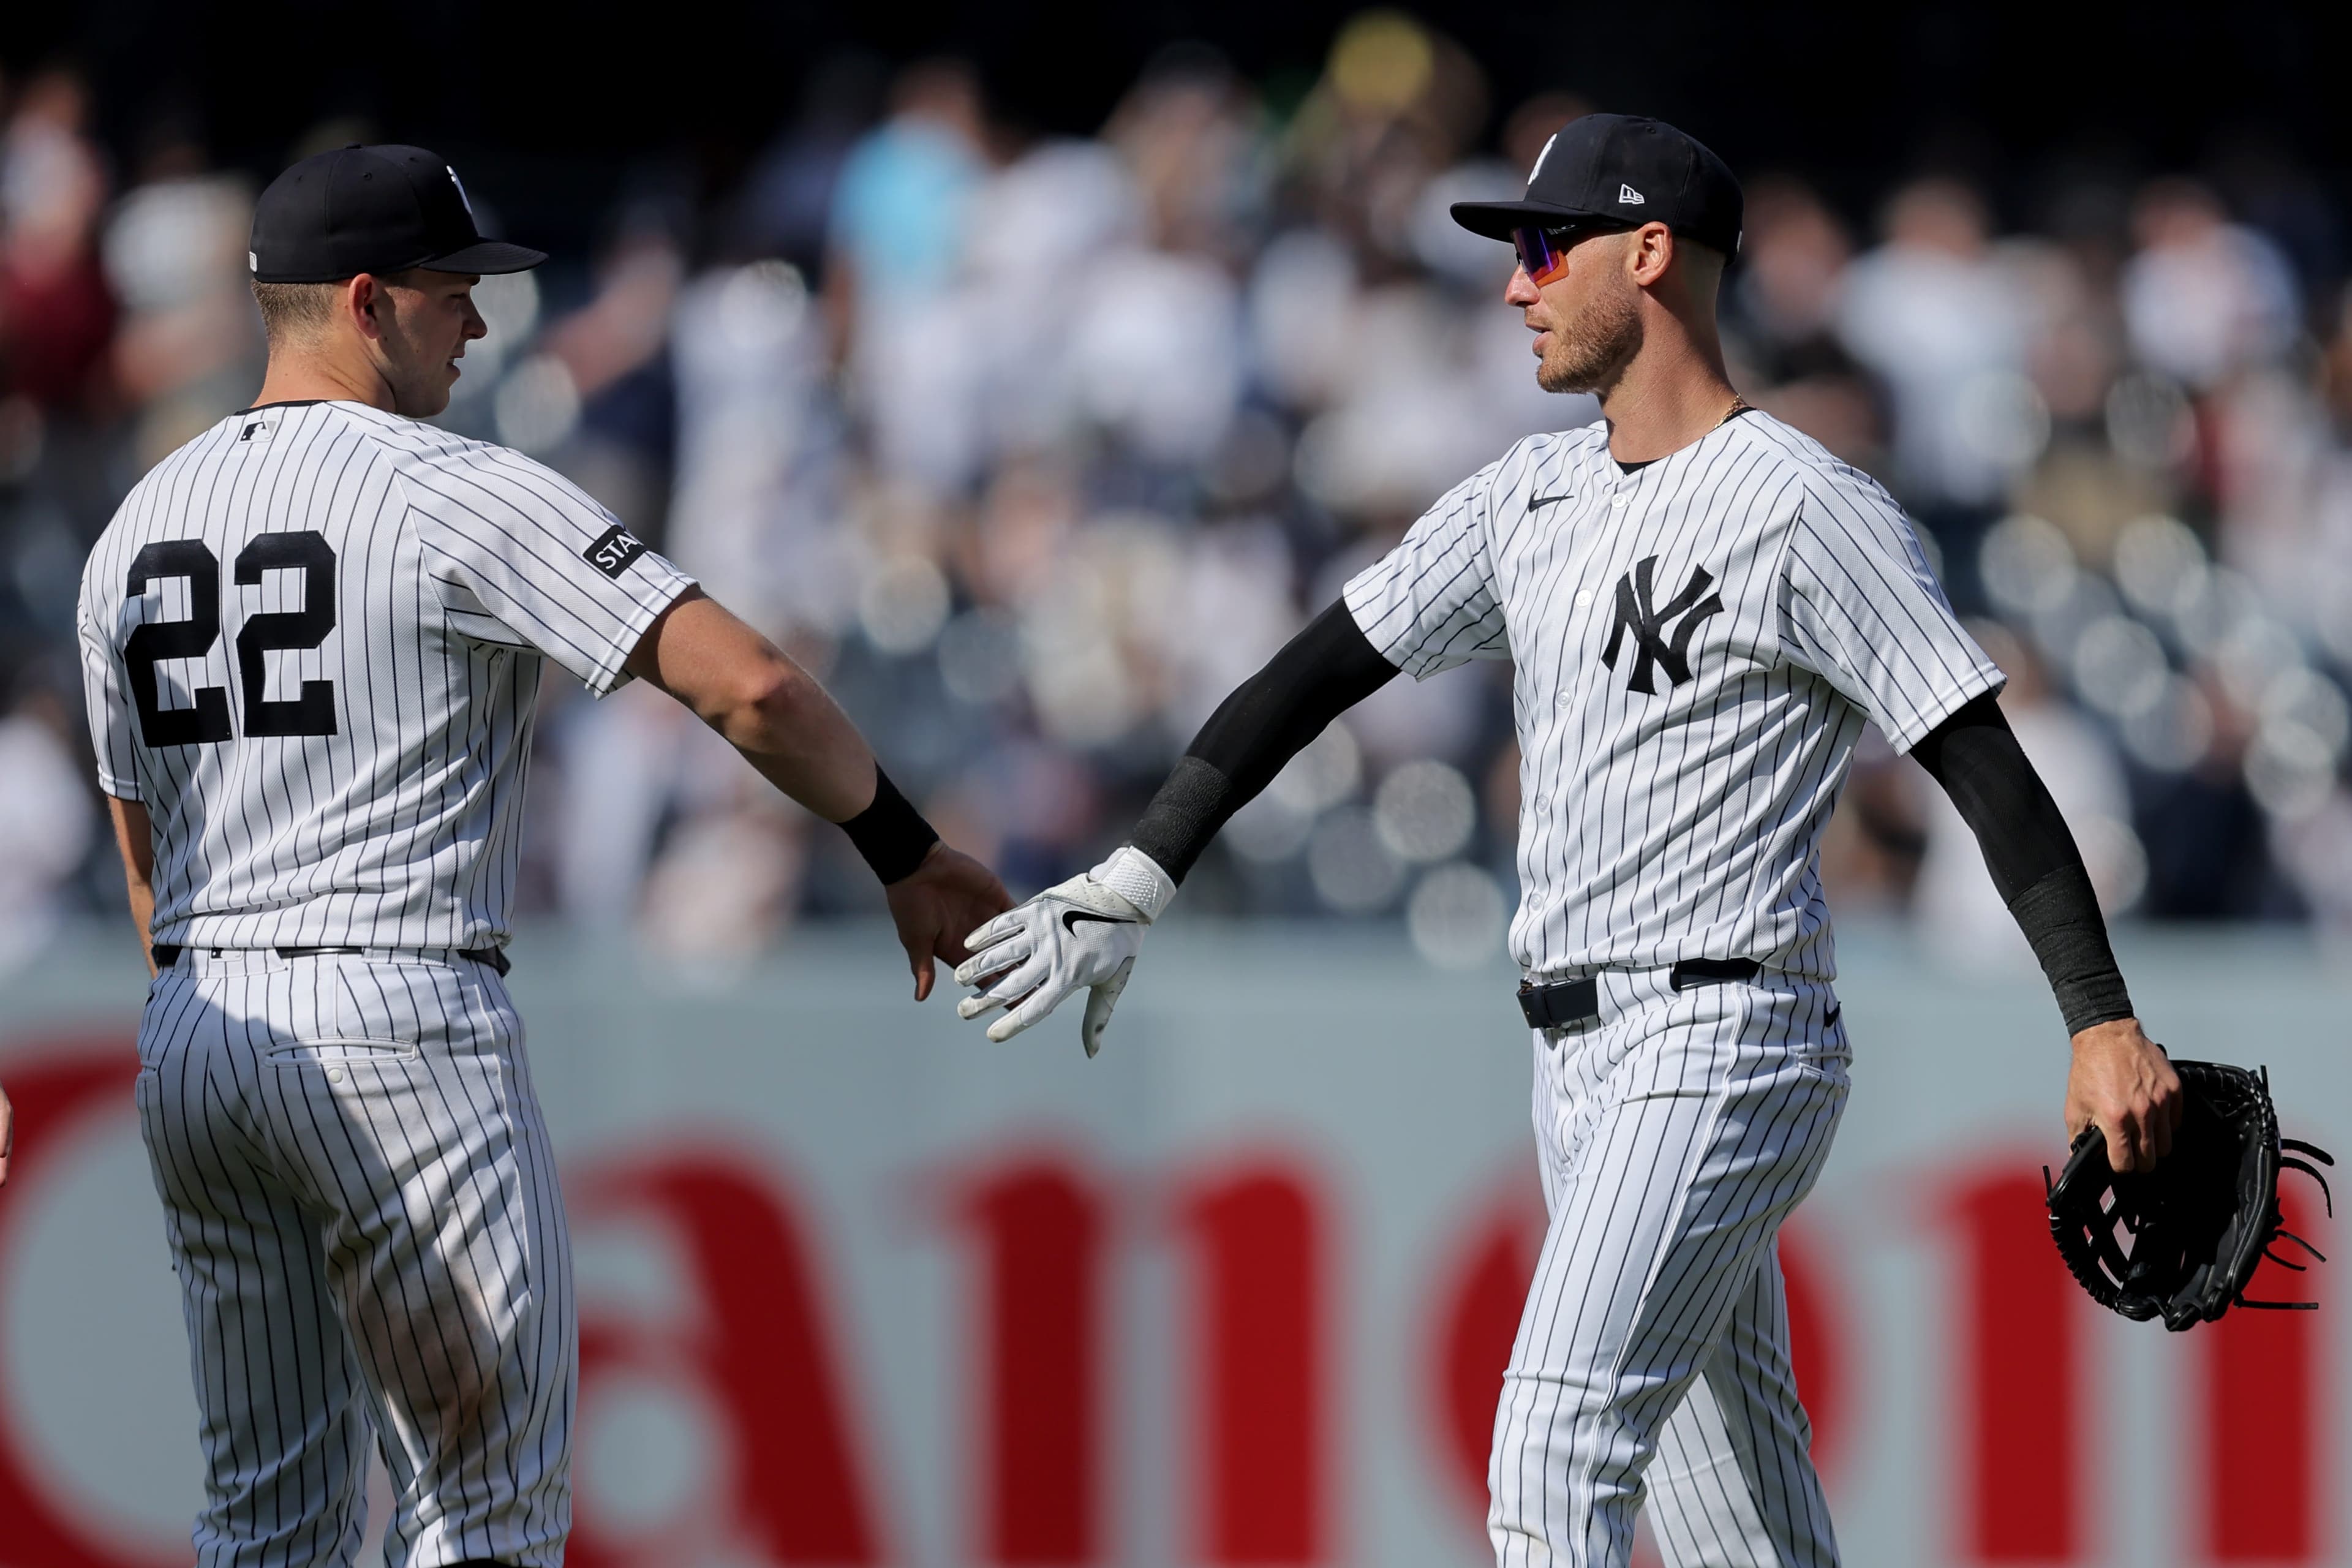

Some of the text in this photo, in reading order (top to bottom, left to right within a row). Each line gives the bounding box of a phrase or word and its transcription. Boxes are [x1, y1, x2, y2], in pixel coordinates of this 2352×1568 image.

[595, 530, 644, 570] STA
[124, 530, 337, 748] 22
[1601, 554, 1725, 696] NY
